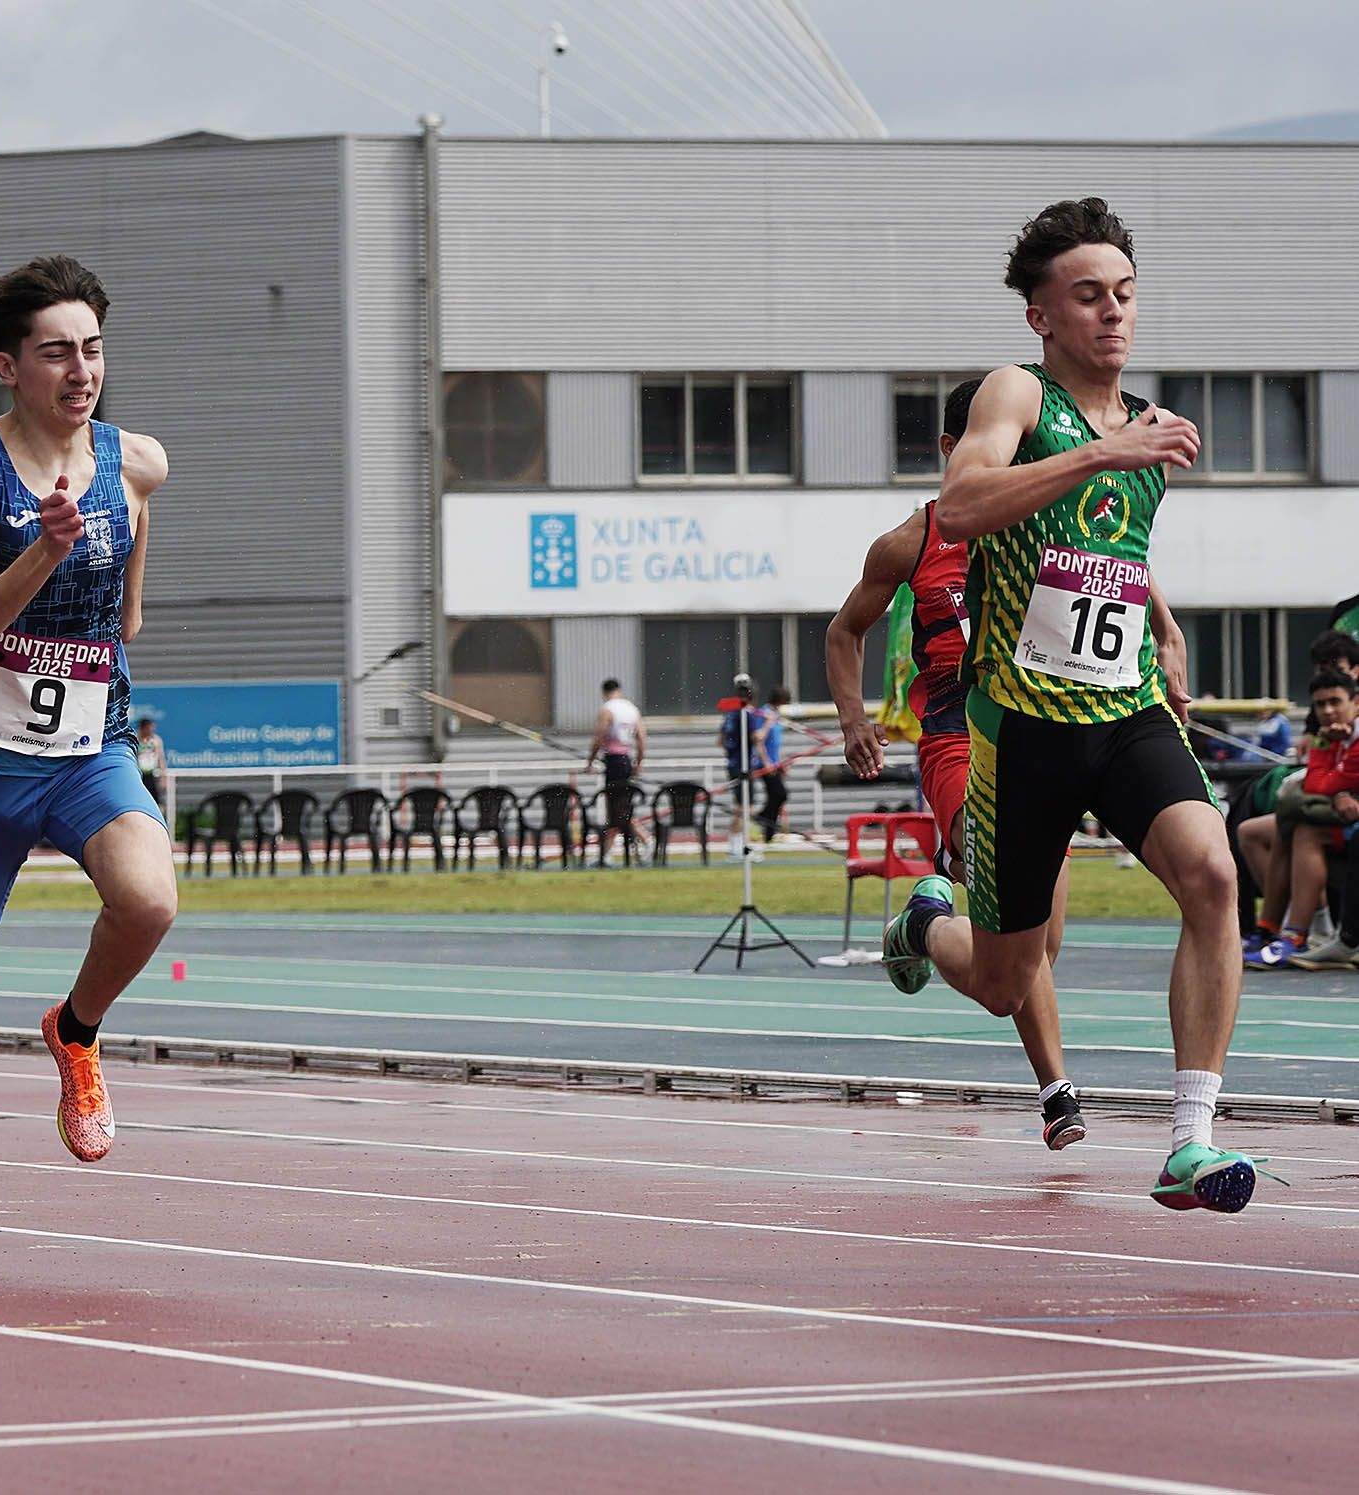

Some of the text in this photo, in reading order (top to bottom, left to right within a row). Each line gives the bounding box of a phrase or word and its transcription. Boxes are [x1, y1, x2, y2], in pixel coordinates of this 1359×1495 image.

[1050, 423, 1082, 438] VIATOR
[591, 516, 706, 546] XUNTA
[591, 551, 780, 584] DE GALICIA
[1043, 548, 1150, 588] PONTEVEDRA
[1080, 576, 1123, 599] 2025
[1070, 596, 1128, 661] 16
[27, 658, 73, 678] 2025
[26, 678, 66, 735] 9
[209, 725, 335, 746] Centro Galego de
[965, 816, 977, 893] LUCUS
